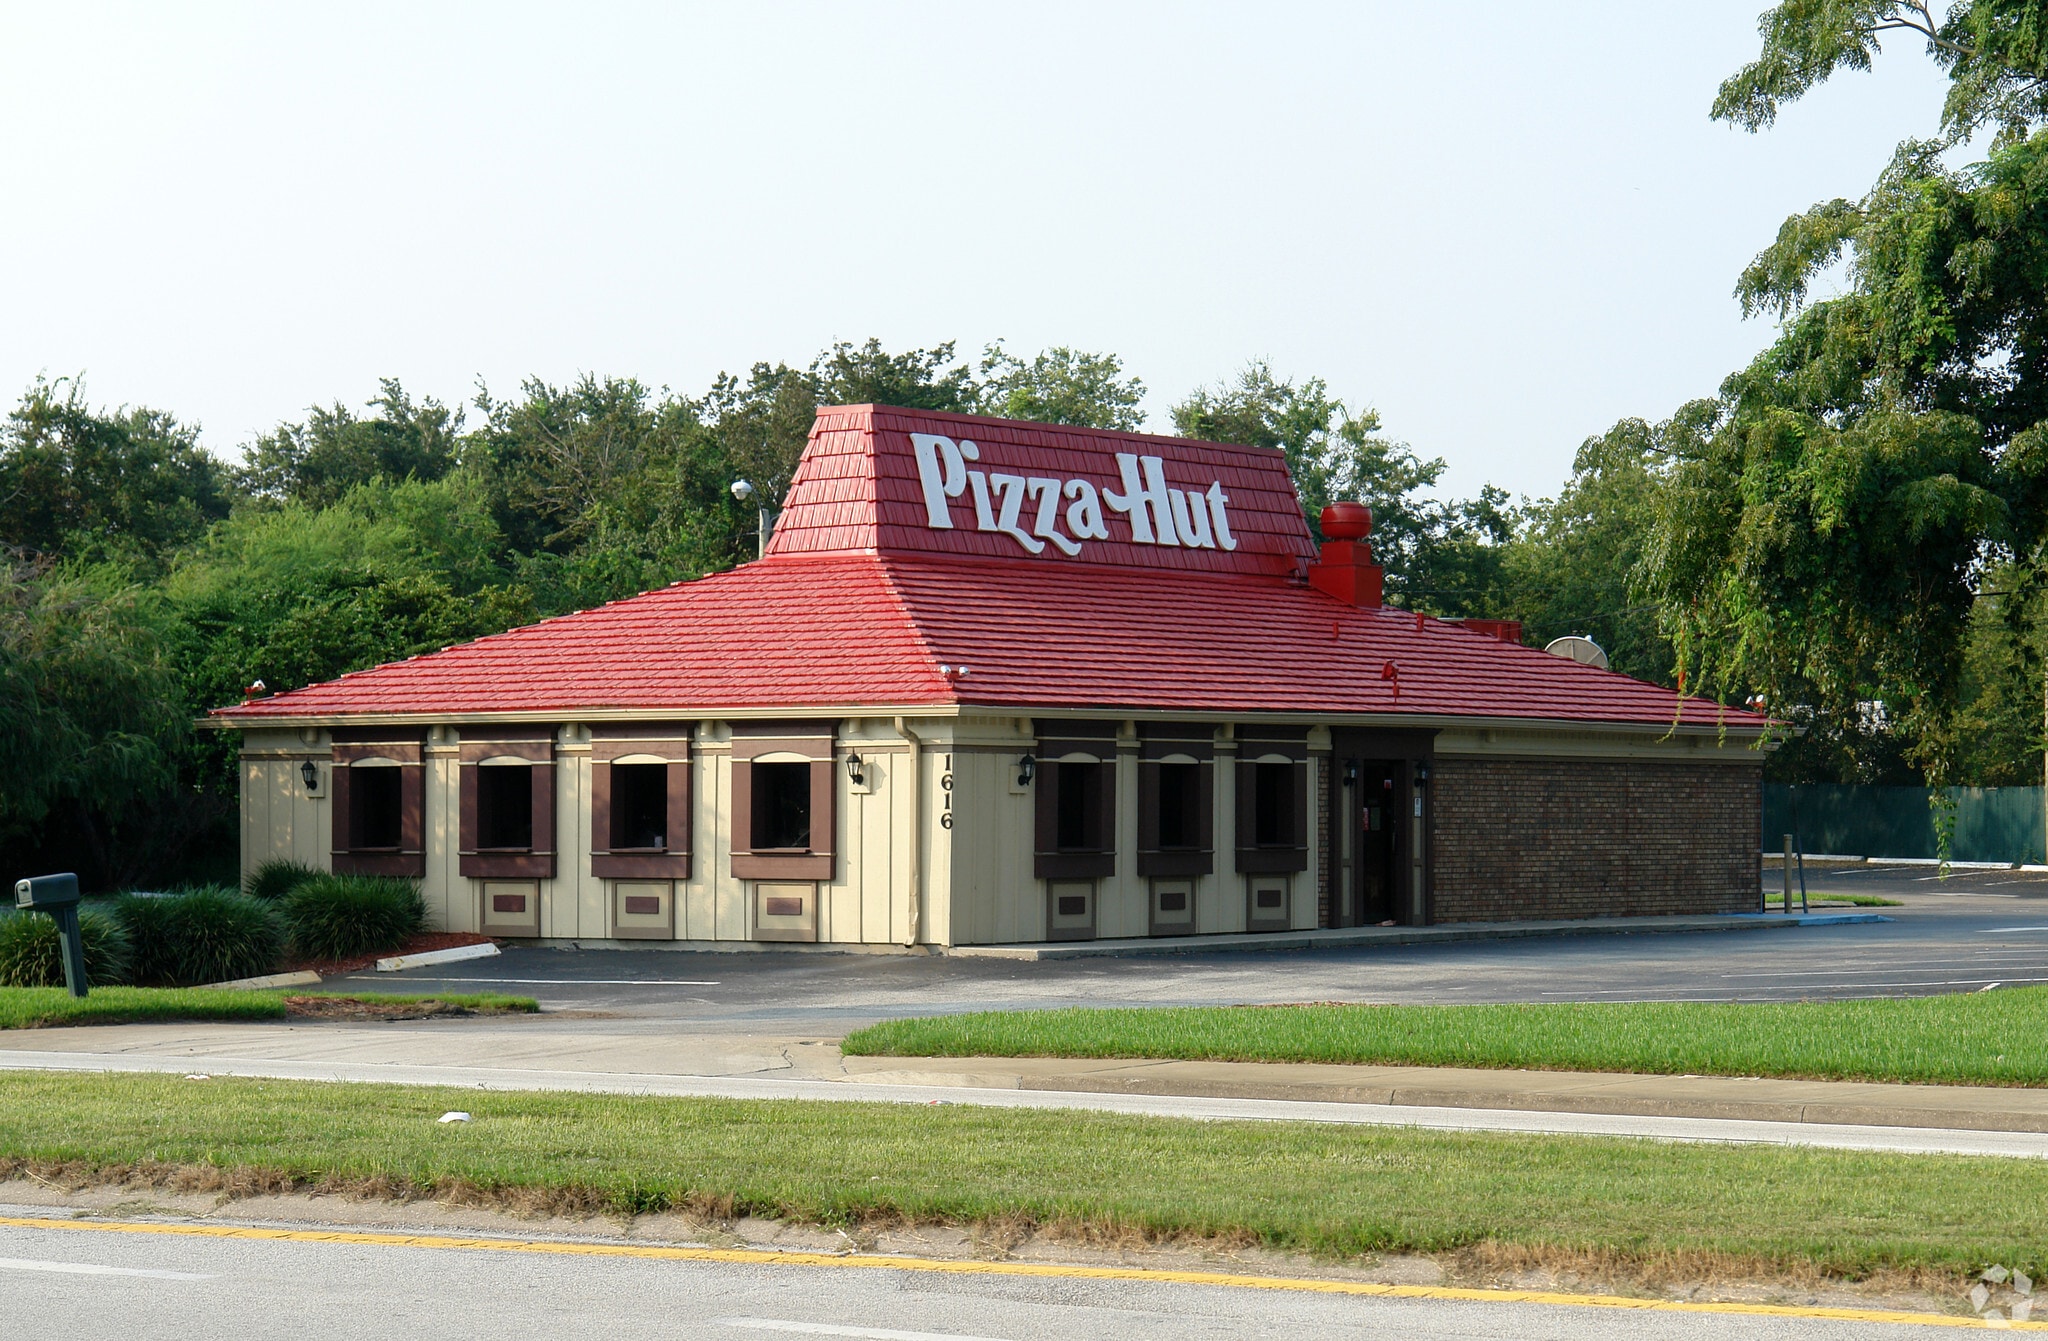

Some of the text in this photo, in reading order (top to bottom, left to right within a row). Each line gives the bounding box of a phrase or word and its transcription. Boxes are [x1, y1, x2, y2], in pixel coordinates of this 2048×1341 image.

[909, 432, 1237, 556] Pizza Hut
[941, 754, 953, 829] 1616
